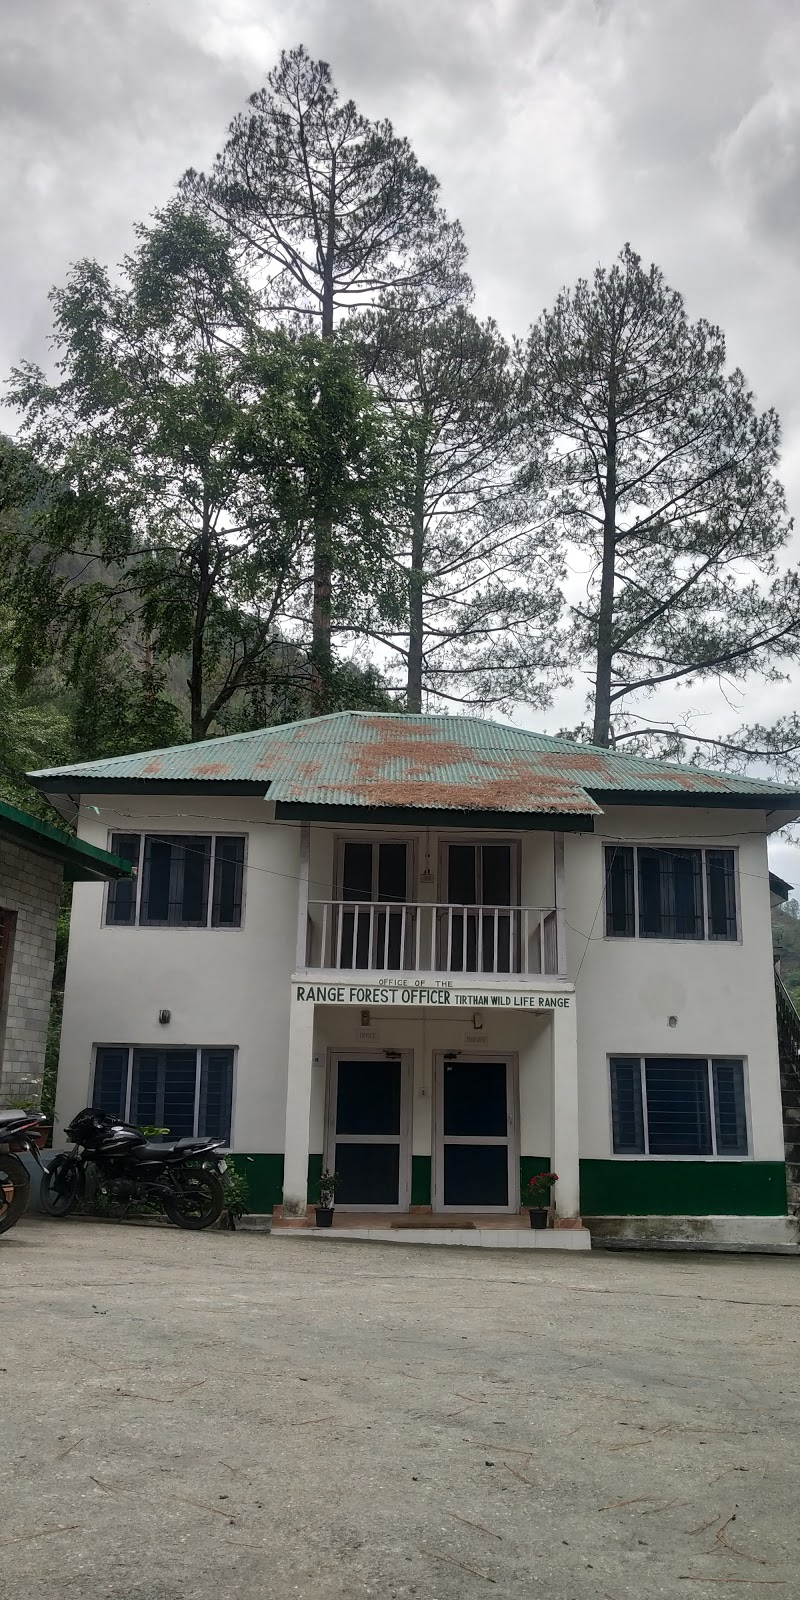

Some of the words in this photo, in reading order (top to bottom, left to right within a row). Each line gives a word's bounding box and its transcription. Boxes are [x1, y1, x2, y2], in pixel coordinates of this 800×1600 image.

[378, 978, 408, 987] OFFICE
[414, 979, 426, 987] OF
[435, 980, 454, 988] THE
[296, 986, 345, 1002] RANGE
[349, 987, 398, 1003] FOREST
[401, 989, 451, 1005] OFFICER
[454, 994, 489, 1006] TIRTHAN
[490, 995, 512, 1006] WILD
[513, 996, 535, 1007] LIFE
[538, 997, 570, 1008] RANGE
